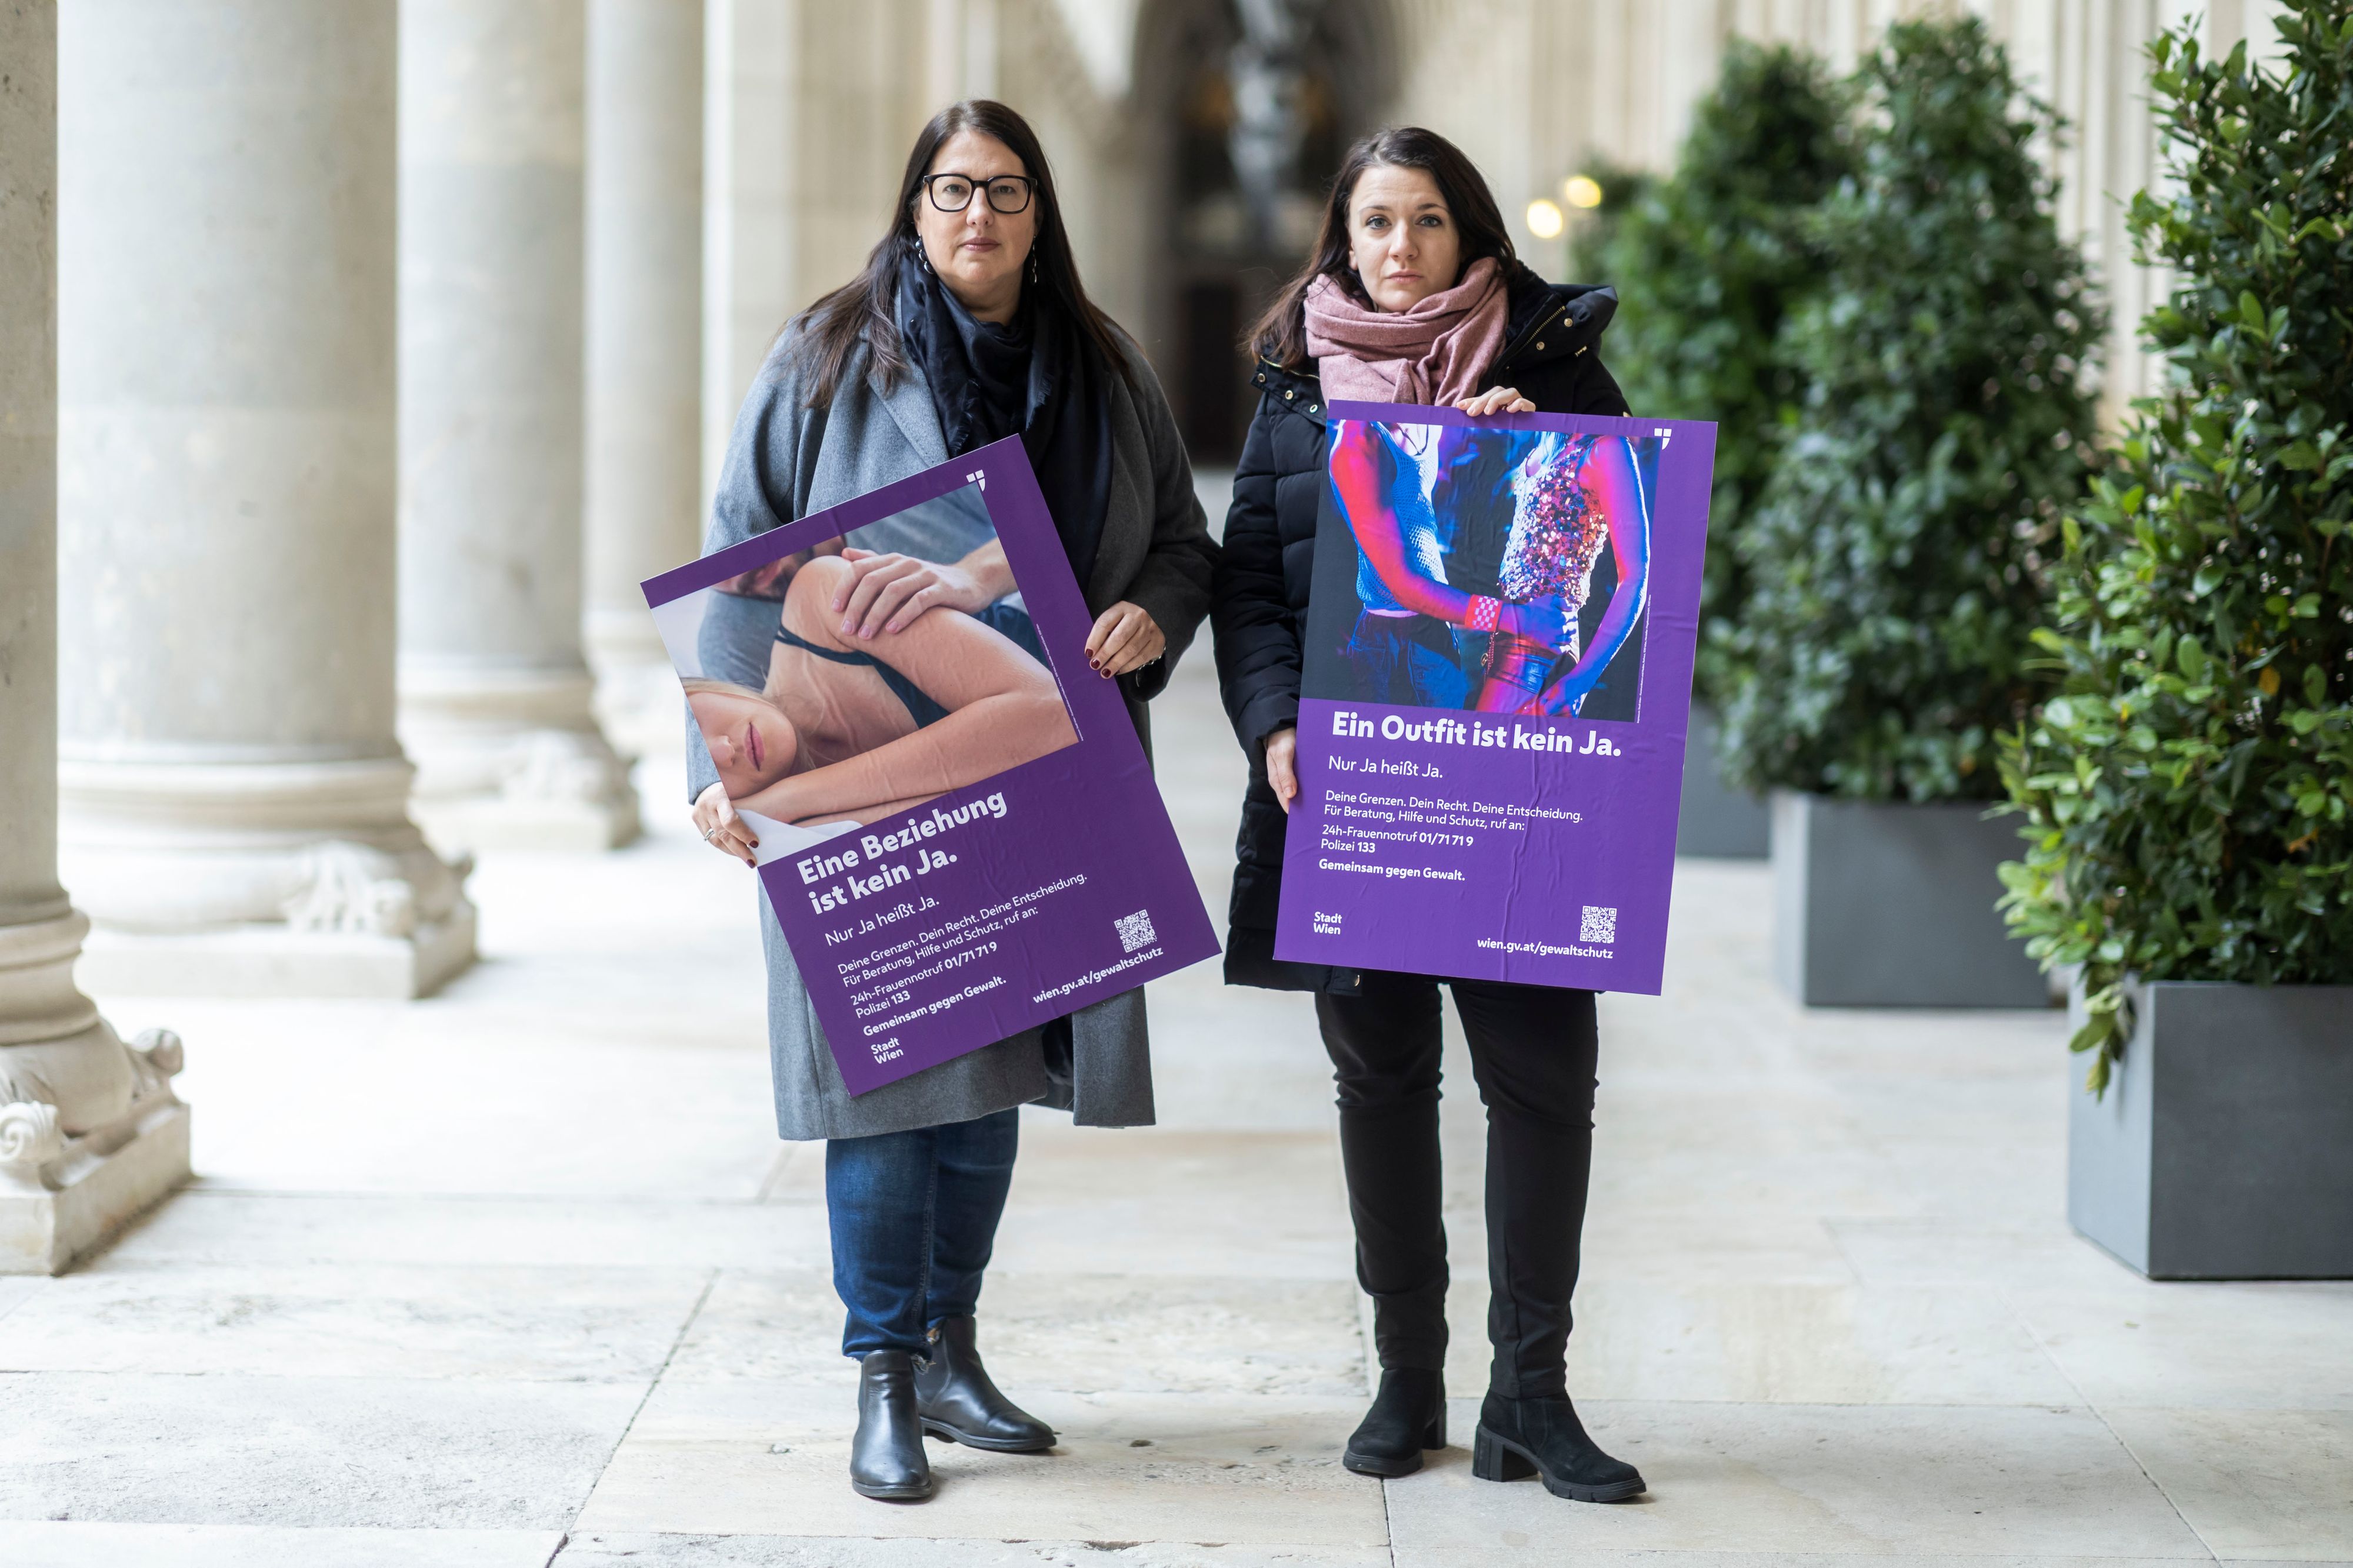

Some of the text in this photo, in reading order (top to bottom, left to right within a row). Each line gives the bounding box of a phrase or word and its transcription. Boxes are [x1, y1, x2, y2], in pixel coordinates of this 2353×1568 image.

[1332, 711, 1621, 757] Ein Outfit ist kein Ja.
[1328, 755, 1443, 778] Nur Ja heißt Ja.
[1324, 804, 1525, 830] Für Beratung, Hilfe und Schutz, ruf an:
[1325, 790, 1583, 823] Deine Grenzen. Dein Recht. Deine Entscheidung.
[796, 792, 1007, 885] Eine Beziehung
[1321, 838, 1375, 853] Polizei 133
[1322, 824, 1418, 842] 24h-Frauennotruf
[808, 849, 958, 915] ist kein Ja.
[1319, 858, 1465, 881] Gemeinsam gegen Gewalt.
[825, 896, 939, 946] Nur Ja heißt Ja.
[837, 873, 1087, 975] Deine Grenzen. Dein Recht. Deine Entscheidung.
[1313, 922, 1341, 935] Wien
[1314, 911, 1342, 924] Stadt
[842, 907, 1038, 987] Für Beratung, Hilfe und Schutz, ruf an:
[1477, 938, 1614, 959] wien.gv.at/gewaltschutz
[850, 961, 943, 1006] 24h-Frauennotruf
[1032, 948, 1164, 1003] wien.gv.at/gewaltschutz
[855, 990, 911, 1019] Polizei 133
[863, 976, 1006, 1036] Gemeinsam gegen Gewalt.
[871, 1037, 900, 1055] Stadt
[874, 1049, 904, 1064] Wien
